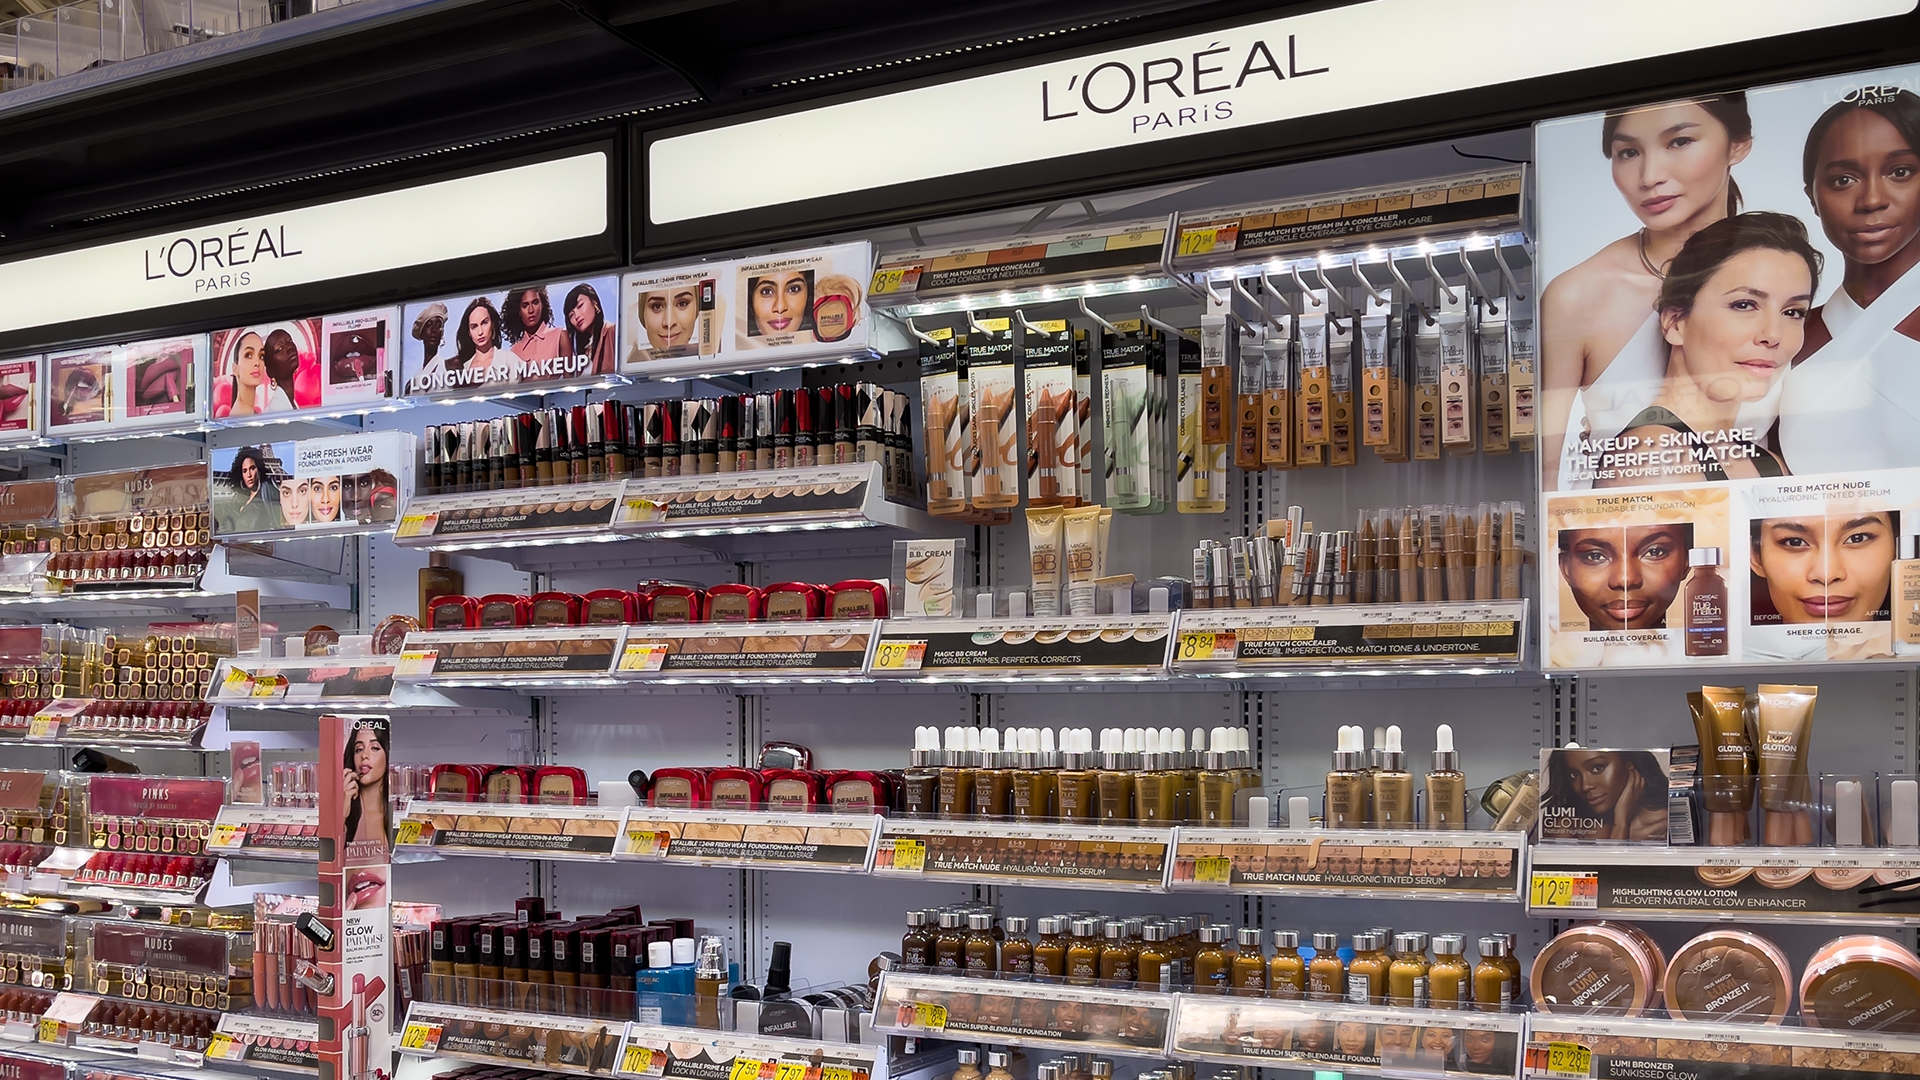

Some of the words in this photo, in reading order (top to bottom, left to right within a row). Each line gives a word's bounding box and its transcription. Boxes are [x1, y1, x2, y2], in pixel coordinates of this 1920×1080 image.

[1041, 33, 1330, 122] L'ORÉAL
[1243, 238, 1267, 247] DARK
[1268, 234, 1298, 244] CIRCLE
[1300, 228, 1347, 241] COVERAGE
[1355, 224, 1373, 232] EYE
[1375, 219, 1406, 230] CREAM
[1408, 215, 1433, 225] CARE
[1244, 231, 1263, 239] TRUE
[1264, 228, 1290, 236] MATCH
[1291, 226, 1305, 234] EYE
[1307, 222, 1334, 232] CREAM
[1352, 214, 1399, 226] CONCEALER
[144, 225, 302, 281] L'ORÉAL
[741, 263, 770, 272] INFALLIBLE
[788, 258, 803, 266] FRESH
[805, 256, 823, 264] WEAR
[950, 269, 972, 278] MATCH
[973, 266, 1000, 275] CRAYON
[1001, 262, 1040, 271] CONCEALER
[632, 278, 658, 287] INFALLIBLE
[676, 273, 691, 281] FRESH
[931, 278, 956, 287] COLOR
[958, 274, 991, 284] CORRECT
[1000, 267, 1045, 279] NEUTRALIZE
[411, 364, 509, 391] LONGWEAR
[514, 354, 589, 378] MAKEUP
[1565, 436, 1640, 455] MAKEUP
[1644, 437, 1654, 447] +
[1659, 427, 1758, 447] SKINCARE.
[302, 451, 322, 460] 24HR
[323, 448, 348, 457] FRESH
[349, 445, 373, 455] WEAR
[1566, 455, 1599, 470] THE
[1603, 449, 1684, 467] PERFECT
[1689, 444, 1761, 462] MATCH.
[298, 458, 334, 468] FOUNDATION
[347, 455, 372, 463] POWDER
[1566, 472, 1616, 482] BECAUSE
[1618, 467, 1659, 478] YOU'RE
[1661, 464, 1706, 475] WORTH
[125, 479, 153, 493] NUDES
[1777, 486, 1802, 494] TRUE
[1806, 484, 1840, 492] MATCH
[1843, 481, 1871, 489] NUDE
[1622, 495, 1653, 503] MATCH
[1758, 493, 1818, 504] HYALURONIC
[1822, 491, 1855, 500] TINTED
[1858, 489, 1891, 498] SERUM
[1556, 505, 1636, 516] SUPER-BLENDABLE
[1639, 501, 1696, 511] FOUNDATION
[1033, 554, 1057, 571] BB
[1069, 553, 1093, 570] BB
[1199, 636, 1213, 649] 84
[1242, 647, 1283, 655] CONCEAL
[1356, 645, 1387, 653] MATCH
[1042, 655, 1082, 663] CORRECTS
[1762, 744, 1797, 753] GLOTION
[142, 788, 169, 800] PINKS
[1543, 806, 1576, 818] LUMI
[1543, 817, 1604, 829] GLOTION
[1566, 828, 1598, 836] highlighter
[934, 861, 952, 869] TRUE
[954, 862, 979, 870] MATCH
[980, 863, 1000, 871] NUDE
[1002, 864, 1050, 874] HYALURONIC
[1052, 866, 1078, 874] TINTED
[1079, 867, 1106, 875] SERUM
[1713, 868, 1732, 876] 904
[1772, 868, 1789, 877] 903
[1832, 869, 1850, 877] 902
[1242, 872, 1264, 880] TRUE
[1265, 873, 1295, 882] MATCH
[1296, 873, 1321, 882] NUDE
[1324, 874, 1380, 884] HYALURONIC
[1382, 875, 1413, 884] TINTED
[1414, 876, 1446, 885] SERUM
[1559, 881, 1570, 894] 97
[1612, 888, 1672, 896] HIGHLIGHTING
[1612, 896, 1661, 905] ALL-OVER
[1663, 897, 1712, 906] NATURAL
[1713, 897, 1745, 906] GLOW
[1747, 898, 1806, 908] ENHANCER
[345, 926, 374, 937] GLOW
[144, 937, 173, 951] NUDES
[1571, 979, 1603, 1008] BRONZE
[1705, 988, 1740, 1012] BRONZE
[1738, 981, 1751, 994] IT
[1848, 1004, 1883, 1027] BRONZE
[1880, 998, 1894, 1011] IT
[763, 1021, 798, 1033] INFALLIBLE
[970, 1023, 1022, 1034] SUPER-BLENDABLE
[1023, 1028, 1062, 1037] FOUNDATION
[1284, 1051, 1347, 1062] SUPER-BLENDABLE
[672, 1066, 687, 1074] LOCK
[673, 1061, 702, 1069] INFALLIBLE
[703, 1063, 720, 1071] PRIME
[1610, 1060, 1631, 1068] LUMI
[1632, 1062, 1674, 1070] BRONZER
[1610, 1068, 1664, 1079] SUNKISSED
[1666, 1071, 1698, 1080] GLOW
